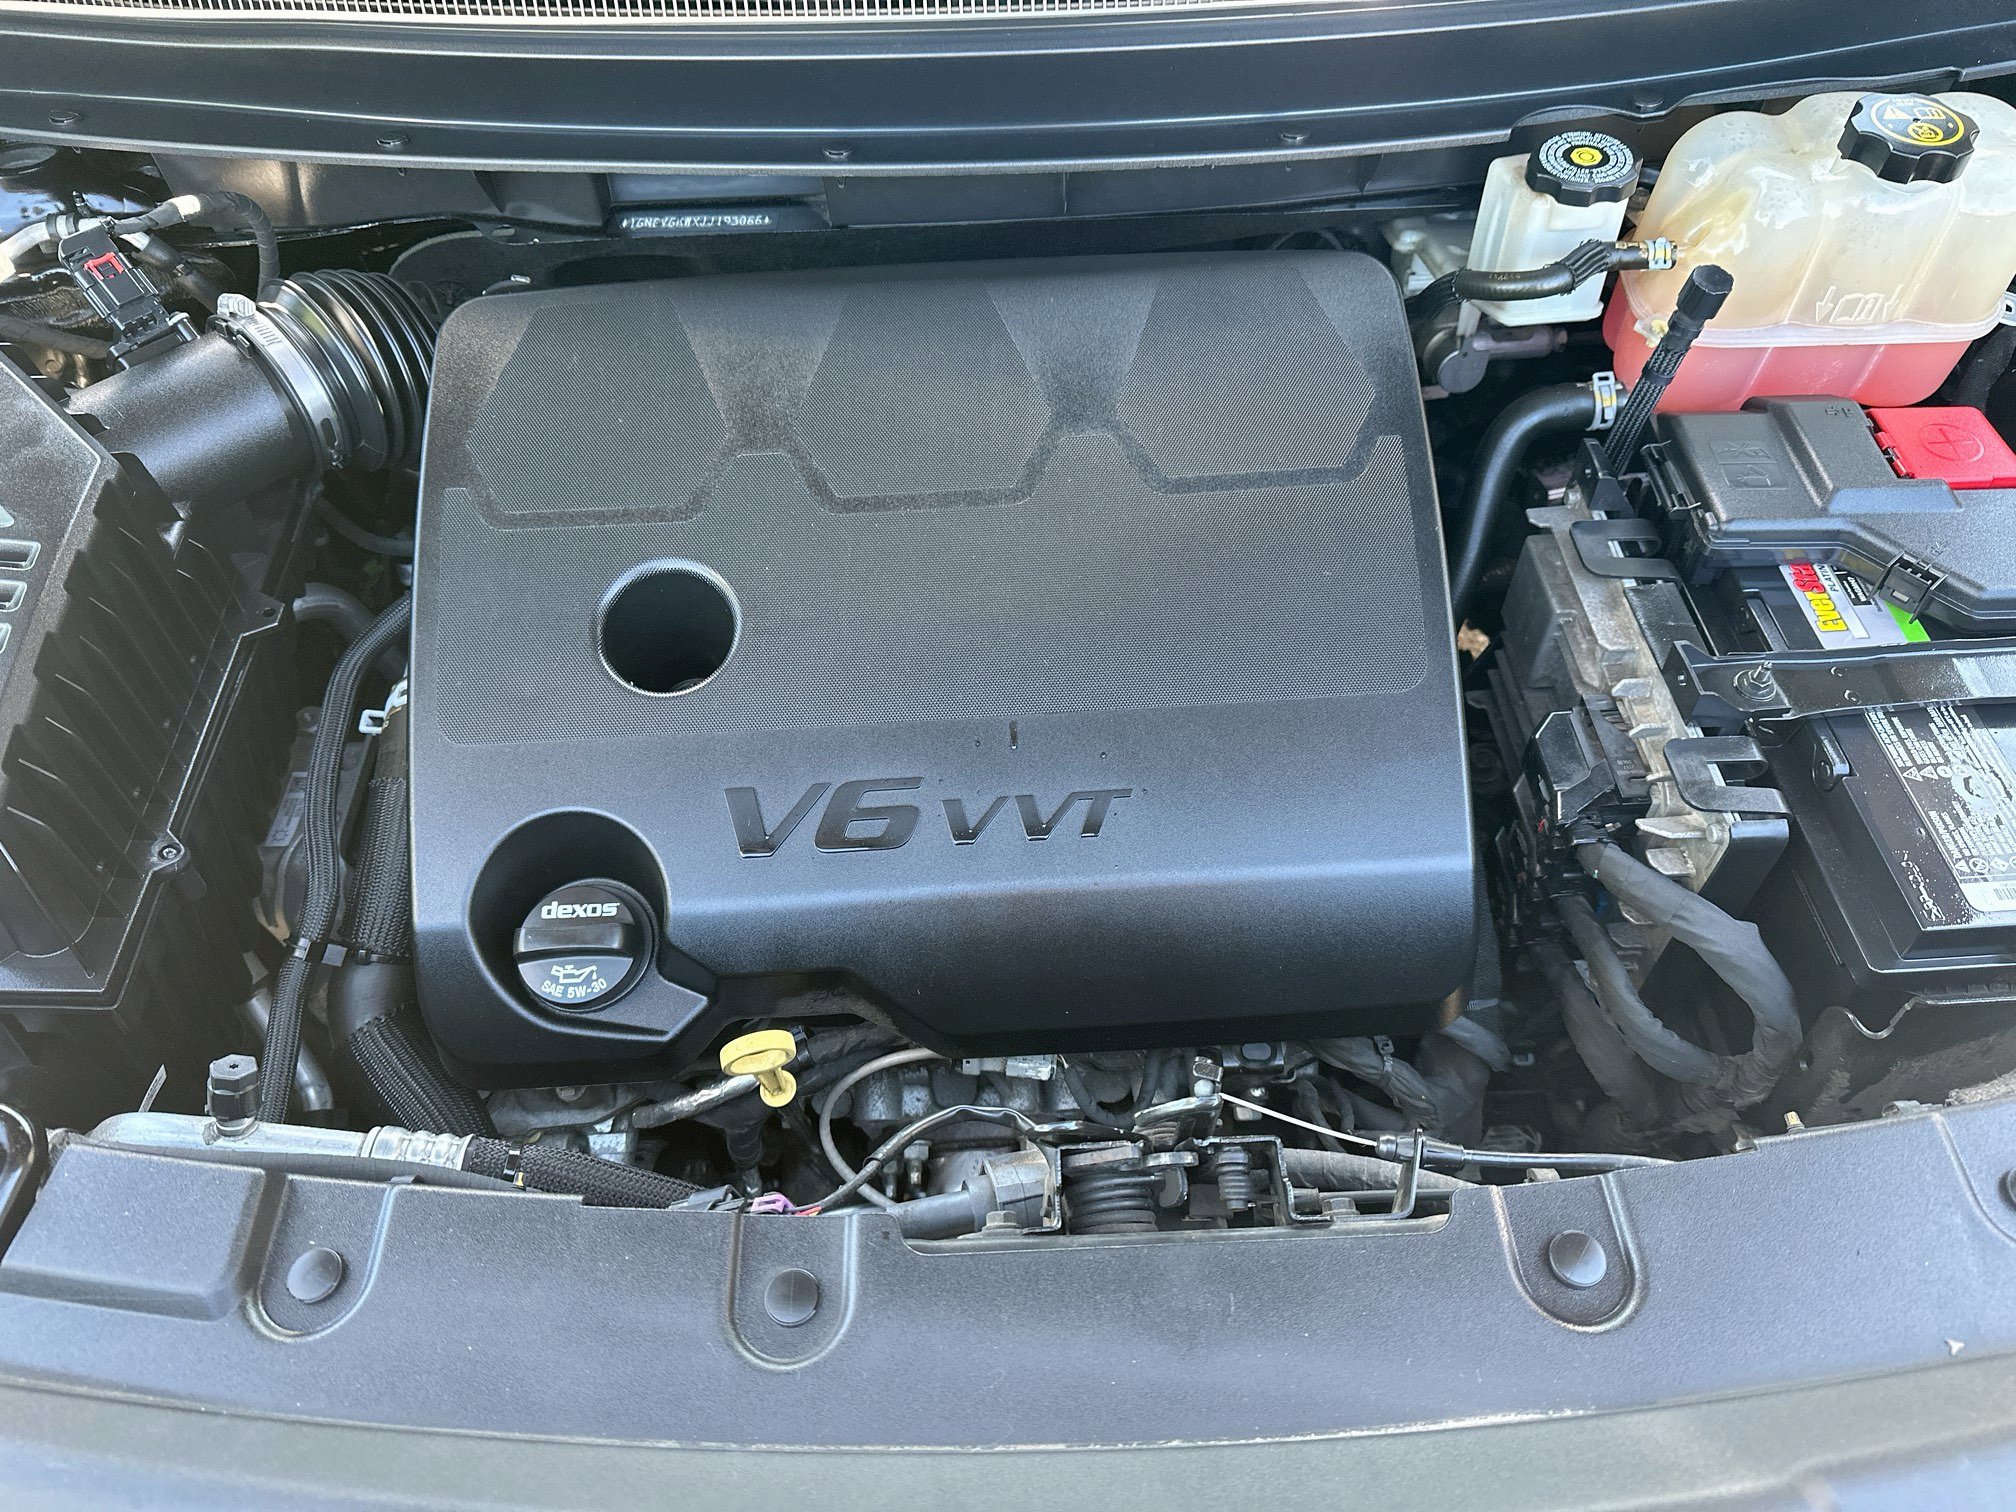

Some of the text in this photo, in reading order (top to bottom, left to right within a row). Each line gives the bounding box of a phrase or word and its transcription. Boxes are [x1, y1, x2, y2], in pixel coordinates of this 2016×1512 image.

[1812, 563, 1839, 592] PLATIN
[1789, 562, 1848, 632] EverSta
[724, 777, 1133, 858] V6 VVT
[541, 901, 620, 919] dexos
[541, 978, 607, 999] SAE 5W-30
